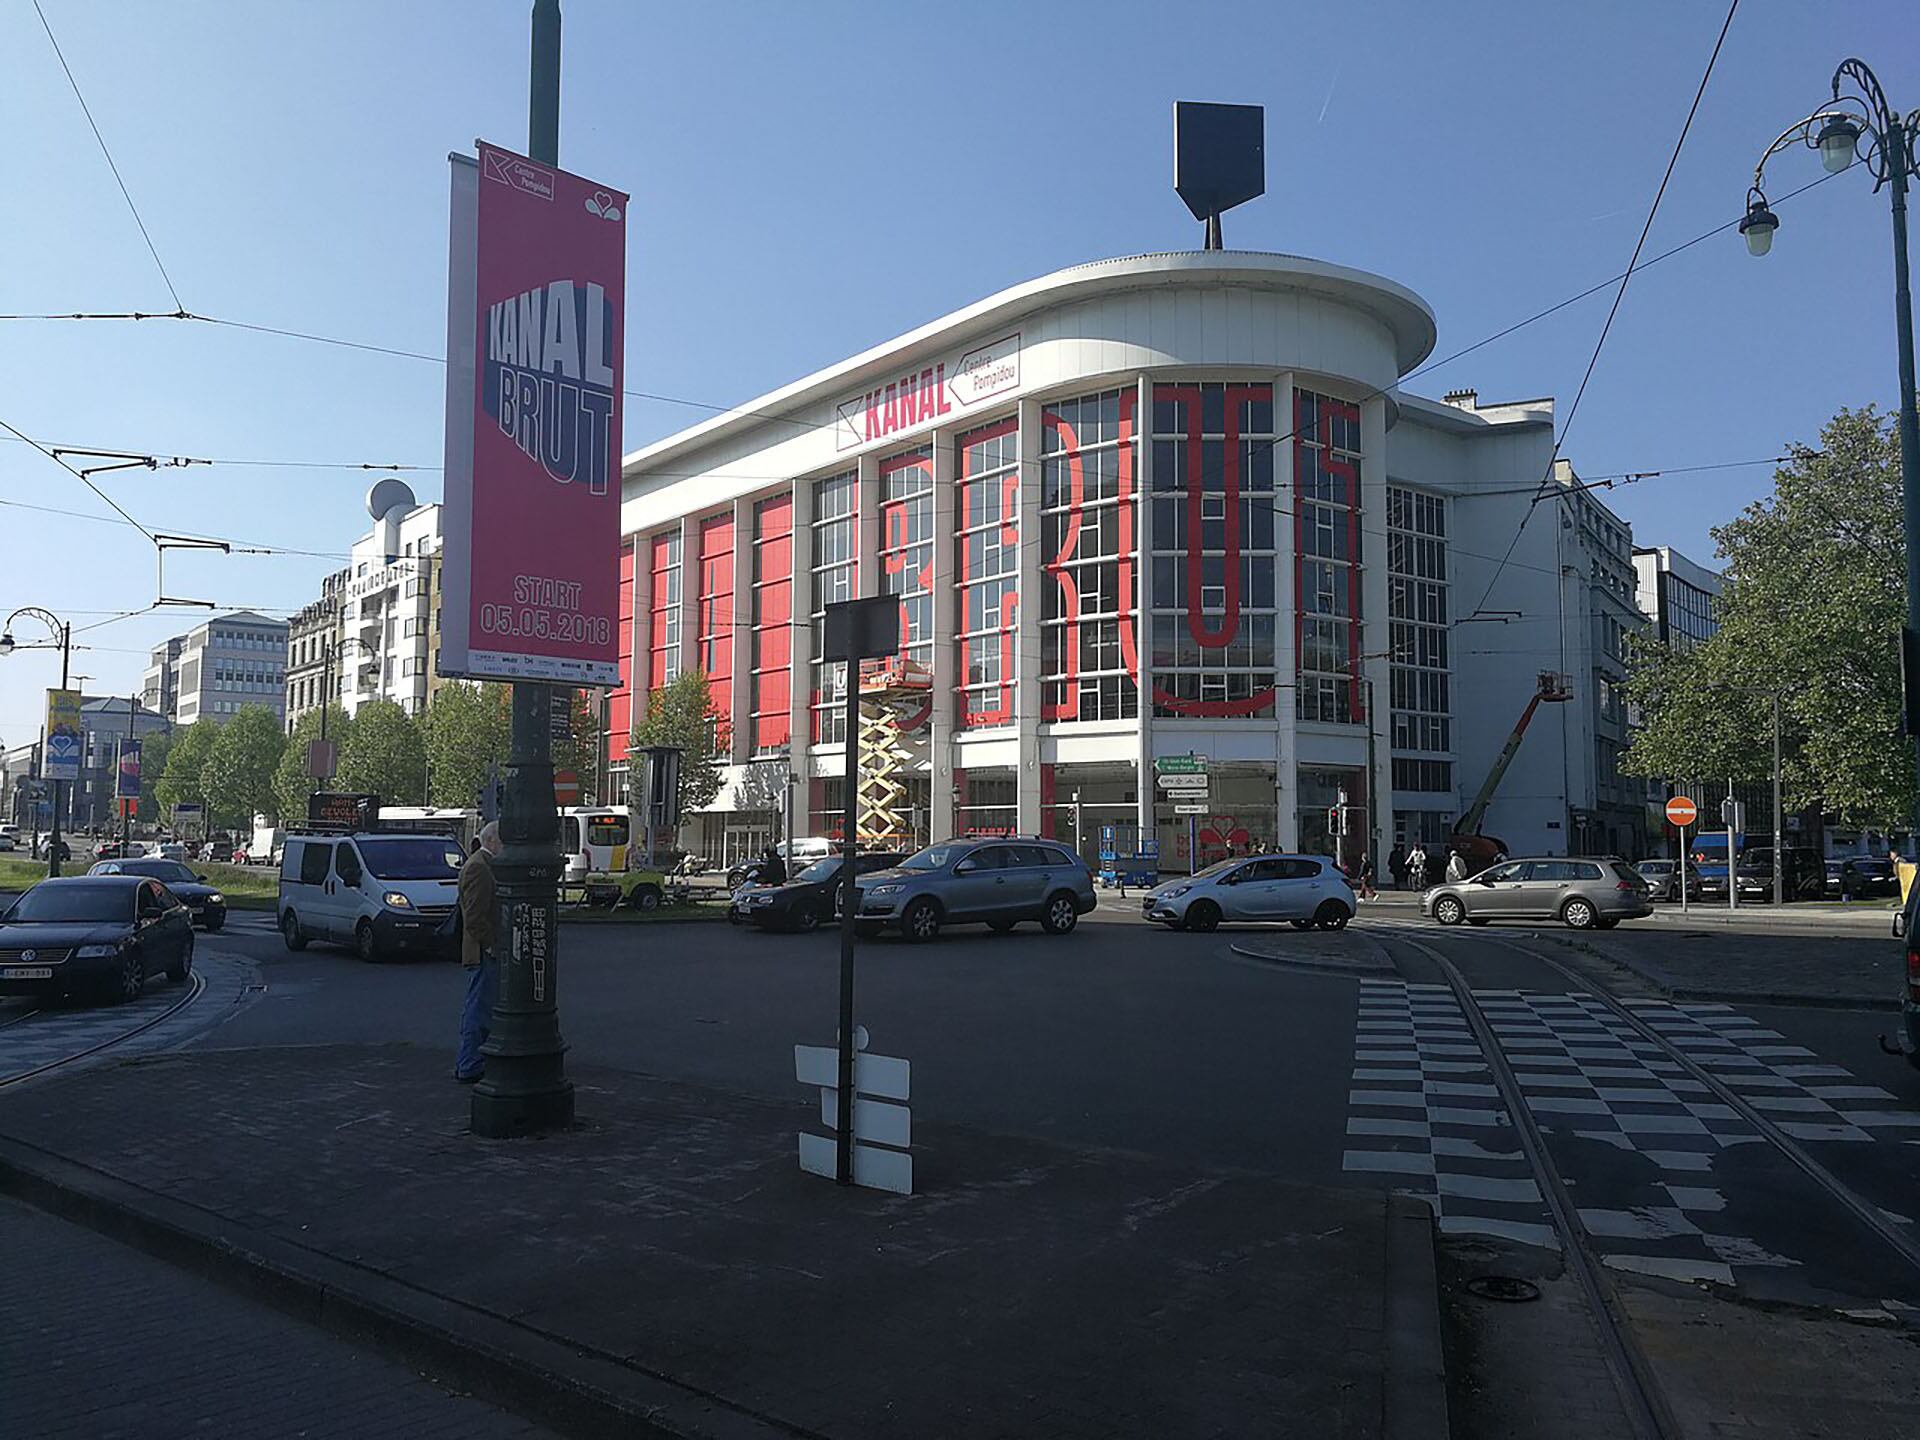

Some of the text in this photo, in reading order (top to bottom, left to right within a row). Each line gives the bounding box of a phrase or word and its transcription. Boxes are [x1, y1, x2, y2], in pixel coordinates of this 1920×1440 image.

[490, 280, 614, 388] KANAL
[963, 354, 993, 376] Centre
[973, 364, 1016, 392] Pompidou
[865, 363, 951, 442] KANAL
[498, 365, 614, 496] BRUT
[514, 574, 583, 610] START
[481, 603, 611, 645] 05.05.2018
